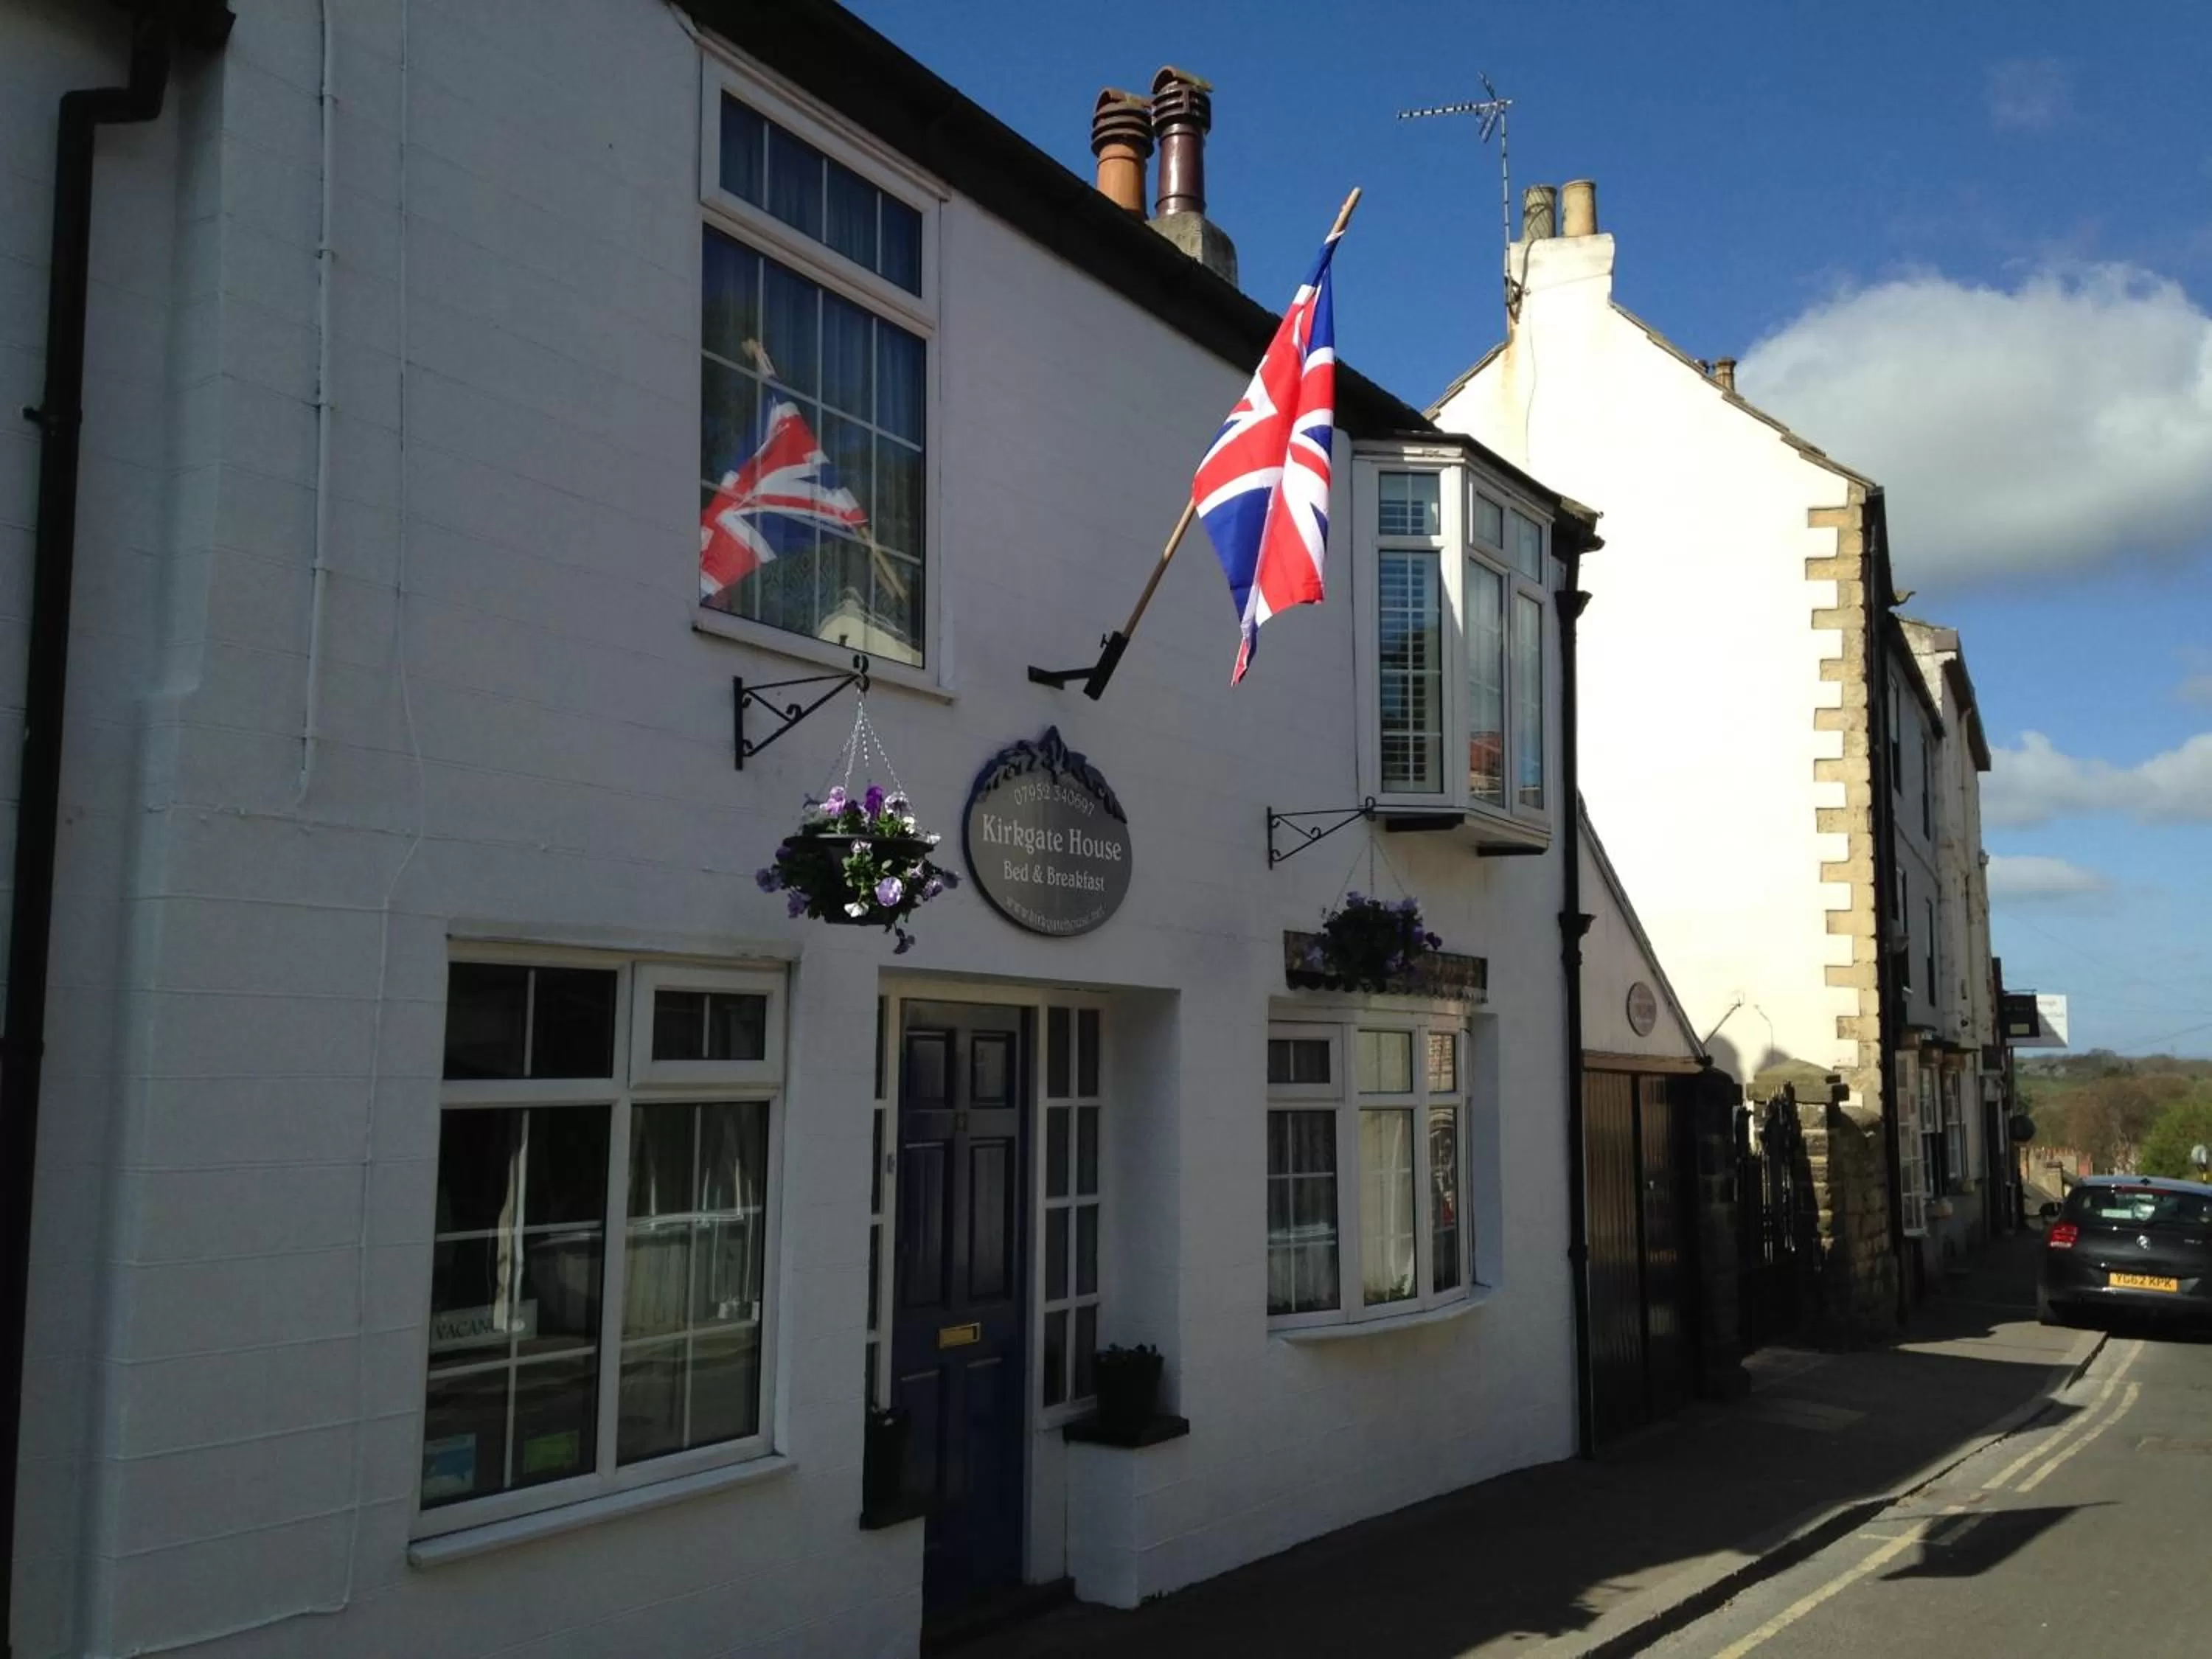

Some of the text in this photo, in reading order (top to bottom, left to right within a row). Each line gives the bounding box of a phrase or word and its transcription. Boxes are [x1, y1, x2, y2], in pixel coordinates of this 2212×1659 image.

[1014, 782, 1051, 806] 07952
[981, 813, 1122, 861] Kirkgate House
[1004, 860, 1105, 891] Bed & Breakfast
